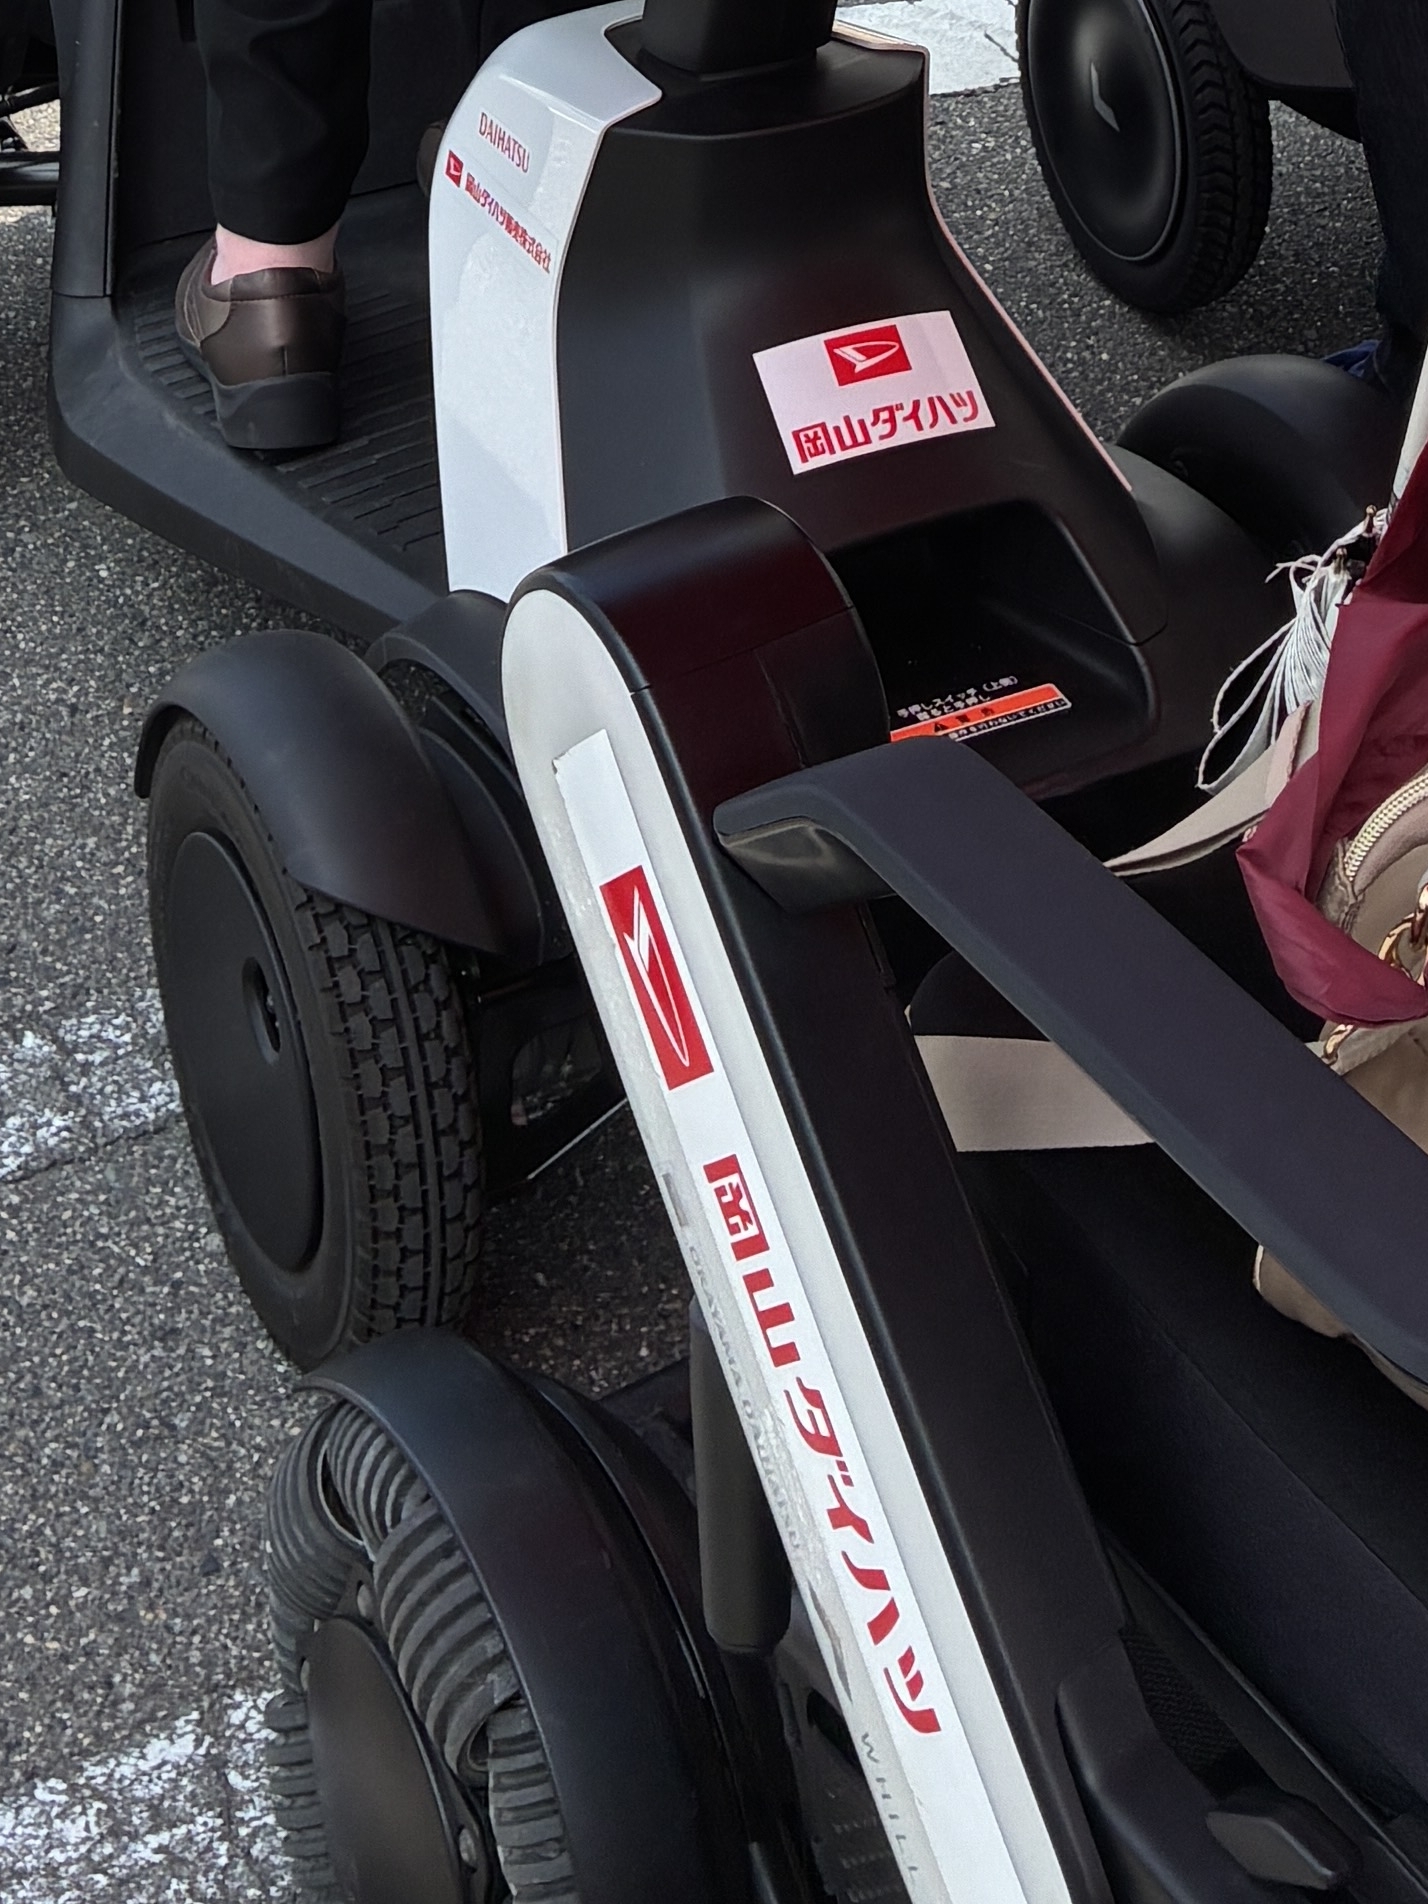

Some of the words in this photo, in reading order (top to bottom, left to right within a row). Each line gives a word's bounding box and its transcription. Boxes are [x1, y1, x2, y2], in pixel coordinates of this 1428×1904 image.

[478, 111, 531, 174] DAIHATSU
[791, 388, 981, 464] 岡山ダイハツ
[702, 1152, 944, 1736] 岡山ダイハツ
